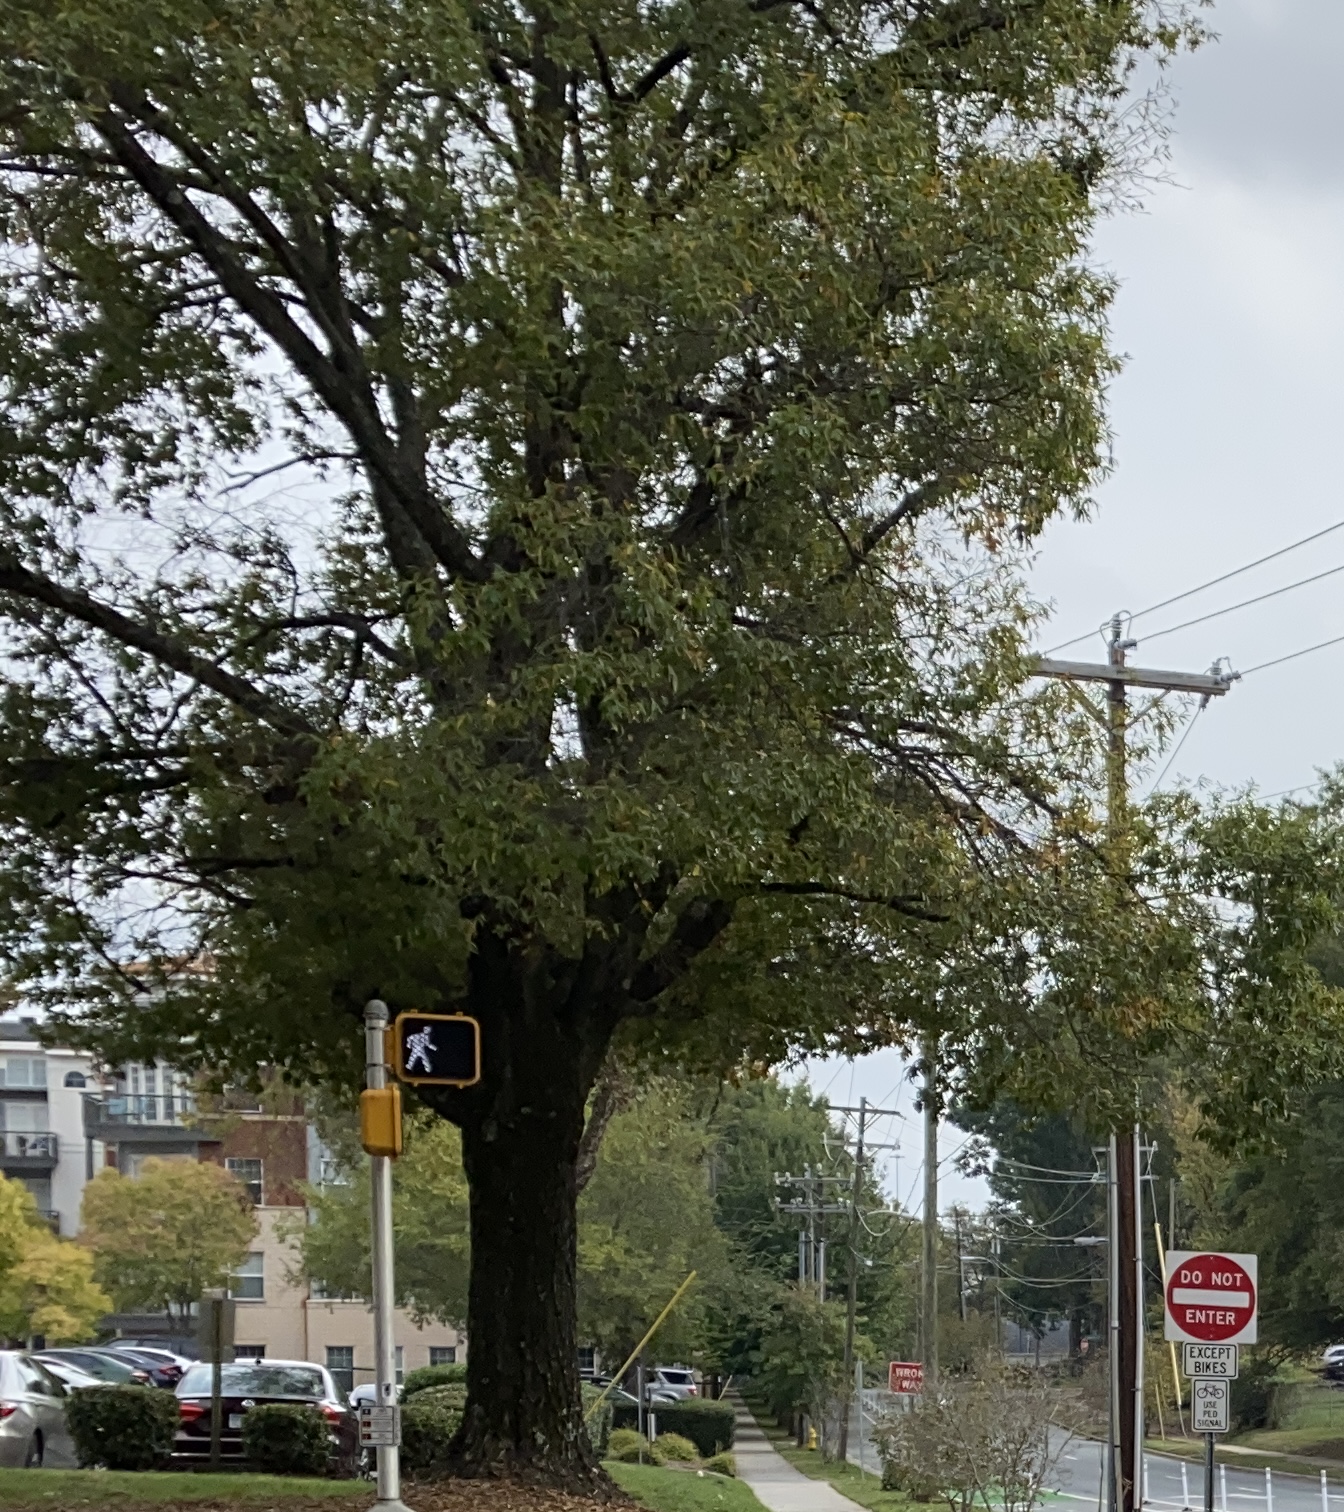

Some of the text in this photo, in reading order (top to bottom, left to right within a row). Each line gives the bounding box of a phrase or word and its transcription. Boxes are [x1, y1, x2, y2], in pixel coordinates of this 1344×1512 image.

[1180, 1270, 1243, 1287] DO NOT
[1185, 1309, 1236, 1326] ENTER
[1189, 1346, 1231, 1360] EXCEPT
[1194, 1361, 1227, 1374] BIKES
[1203, 1401, 1218, 1409] USE
[1203, 1410, 1218, 1418] PED
[1197, 1419, 1223, 1428] SIGNAL
